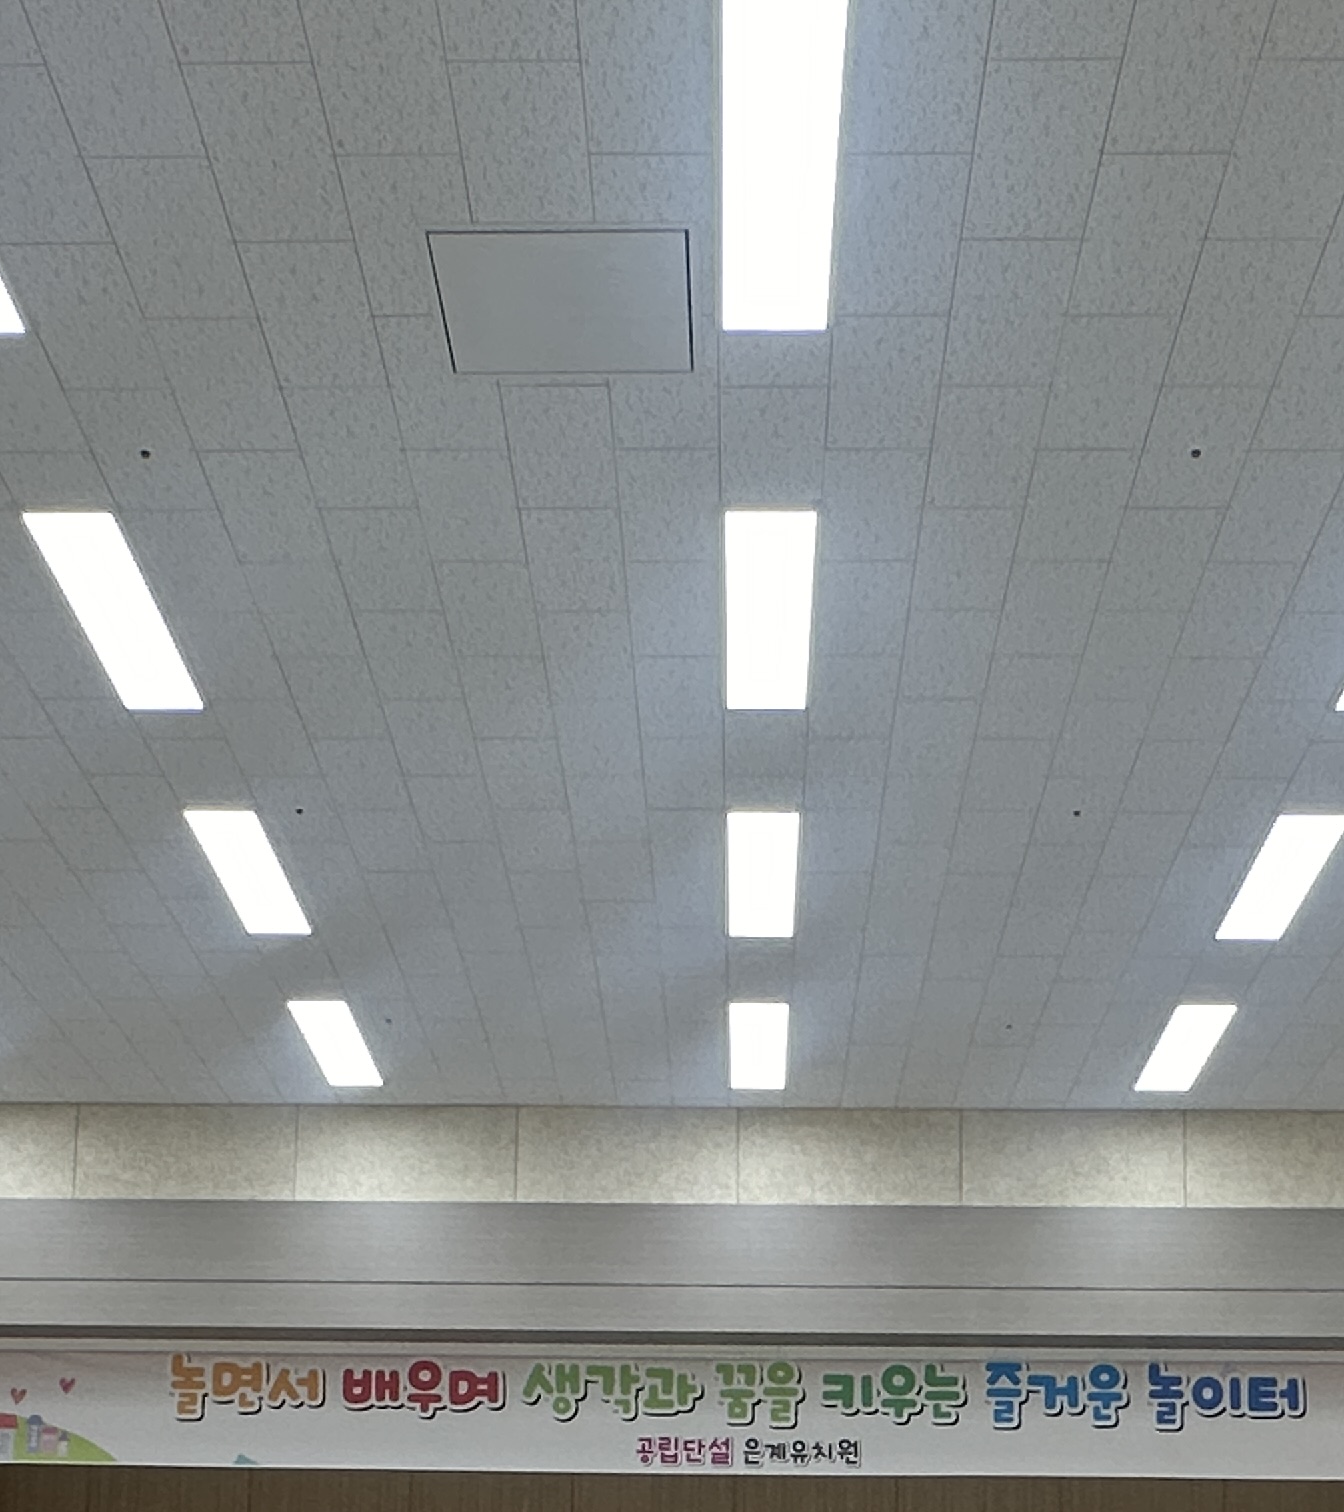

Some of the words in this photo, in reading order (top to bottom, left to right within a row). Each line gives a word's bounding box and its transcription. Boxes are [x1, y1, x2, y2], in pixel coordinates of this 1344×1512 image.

[169, 1353, 322, 1417] 놀면서
[341, 1359, 502, 1415] 배우며
[521, 1362, 701, 1417] 생각과
[714, 1360, 802, 1424] 꿈을
[821, 1363, 962, 1420] 키우는
[984, 1361, 1125, 1425] 즐거운
[1147, 1362, 1301, 1426] 놀이터
[635, 1436, 733, 1466] 공립단설
[742, 1437, 861, 1465] 은계유치원
